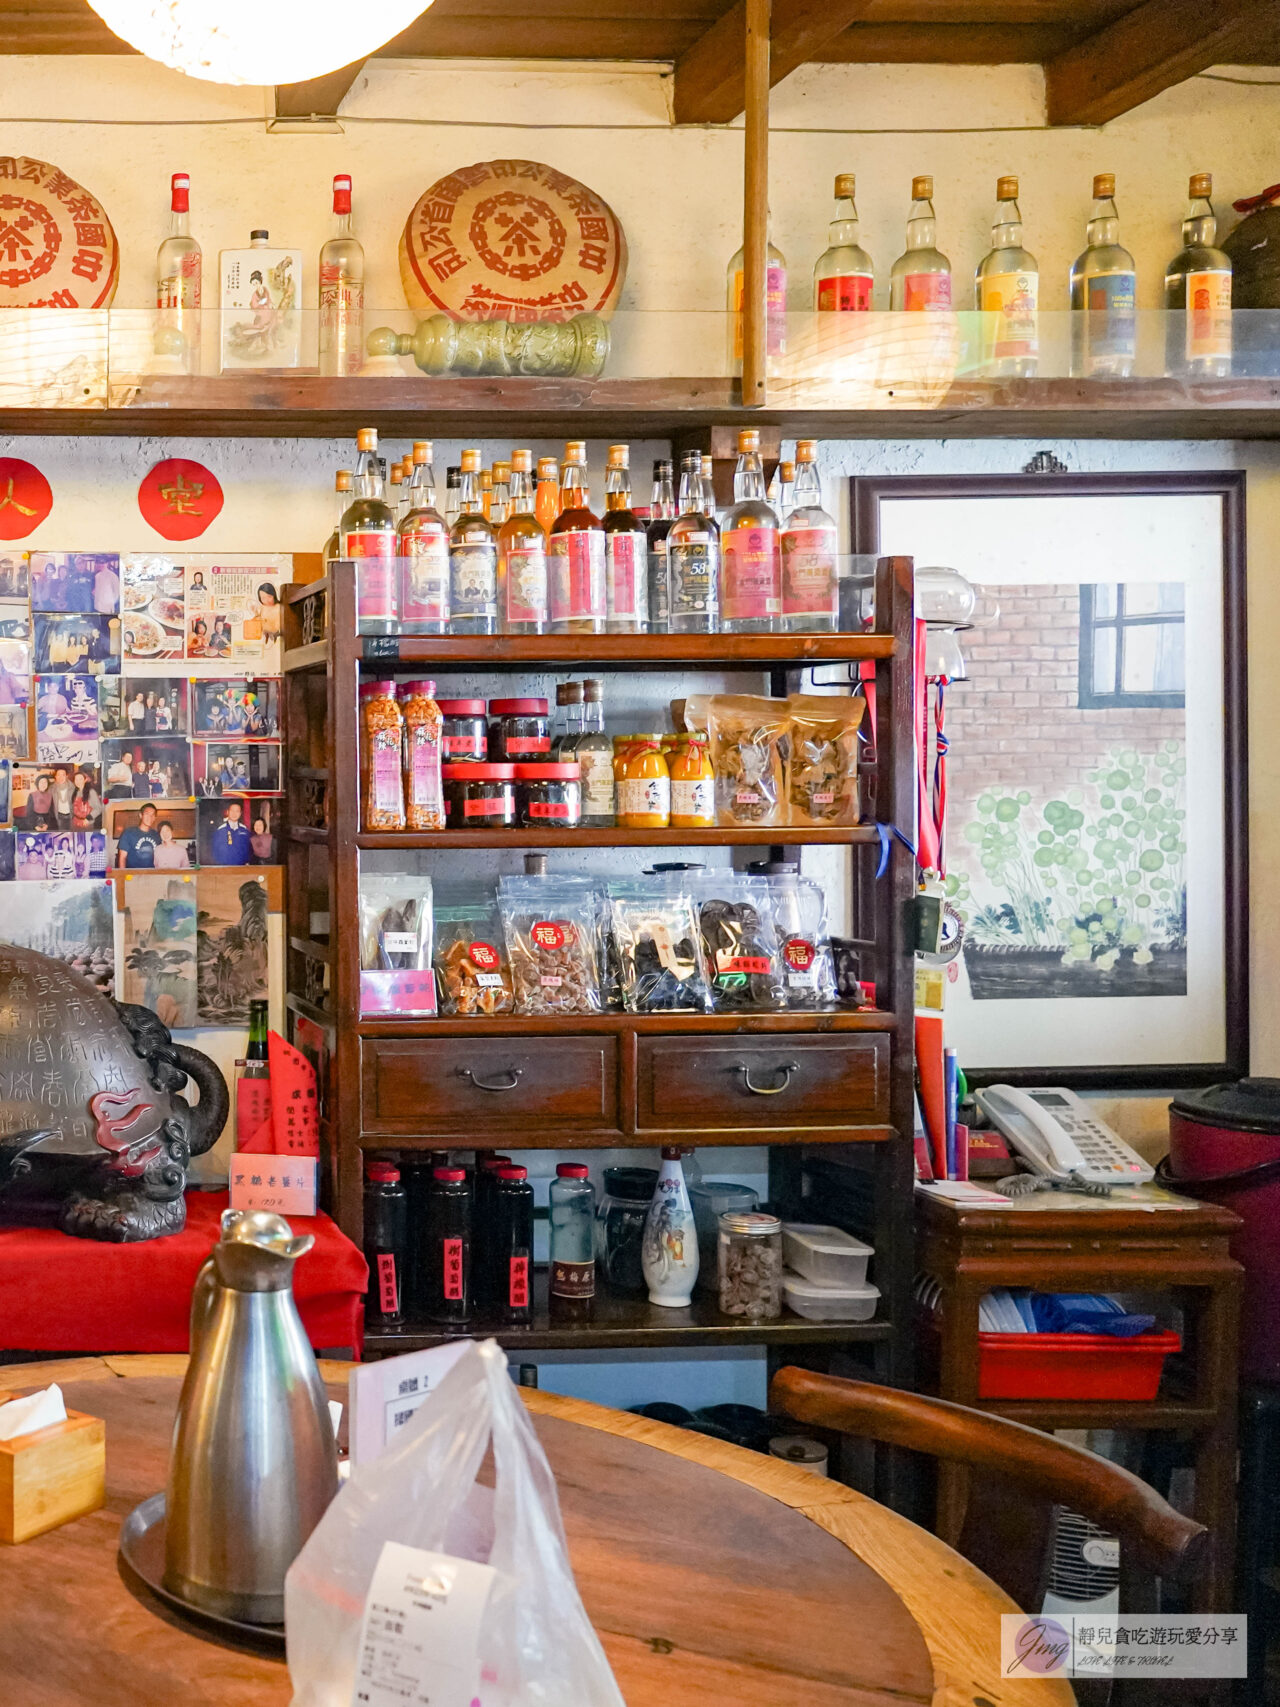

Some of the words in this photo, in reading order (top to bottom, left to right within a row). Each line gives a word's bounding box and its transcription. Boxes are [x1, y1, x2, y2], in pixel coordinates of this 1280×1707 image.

[158, 474, 205, 517] 堂
[690, 562, 706, 575] 58
[536, 927, 557, 945] 福
[473, 948, 493, 964] 福
[789, 946, 808, 965] 福
